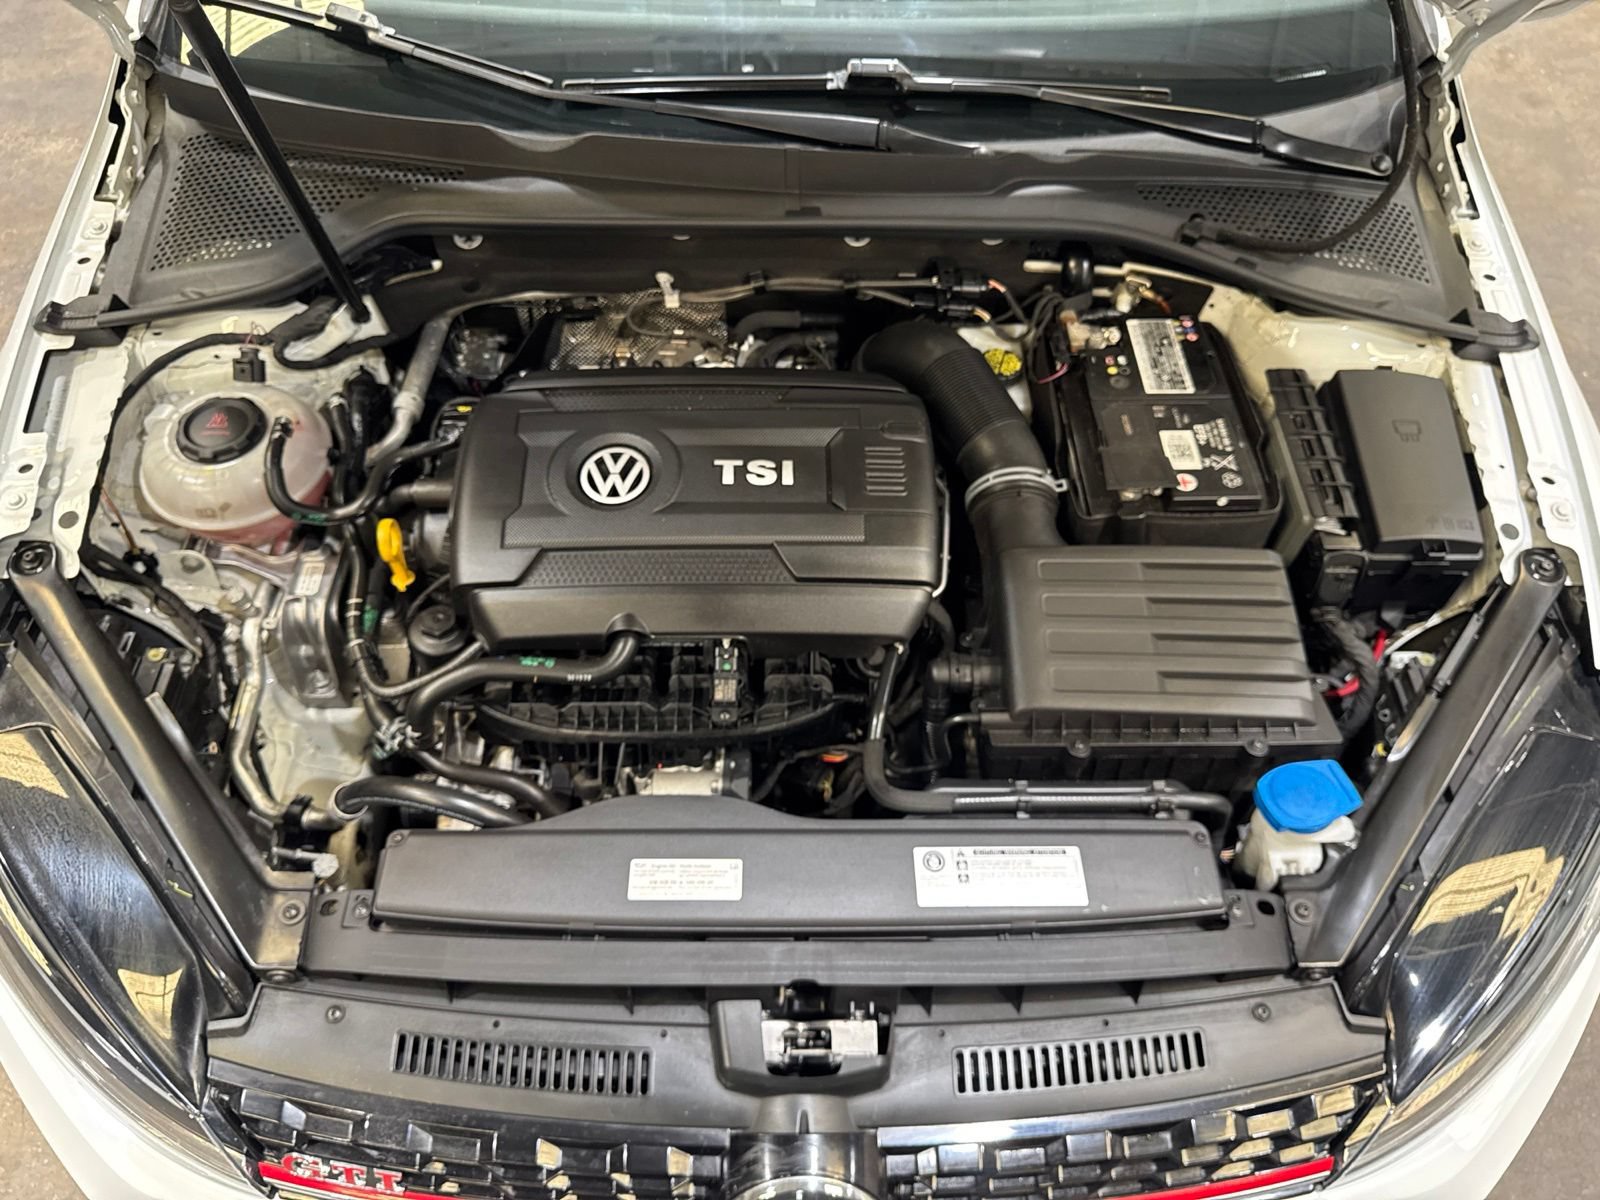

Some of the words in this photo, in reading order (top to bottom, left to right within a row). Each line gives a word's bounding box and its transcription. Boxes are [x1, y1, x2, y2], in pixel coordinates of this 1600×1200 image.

[580, 447, 650, 505] VW
[713, 459, 795, 486] TSI
[281, 1152, 405, 1194] GTI
